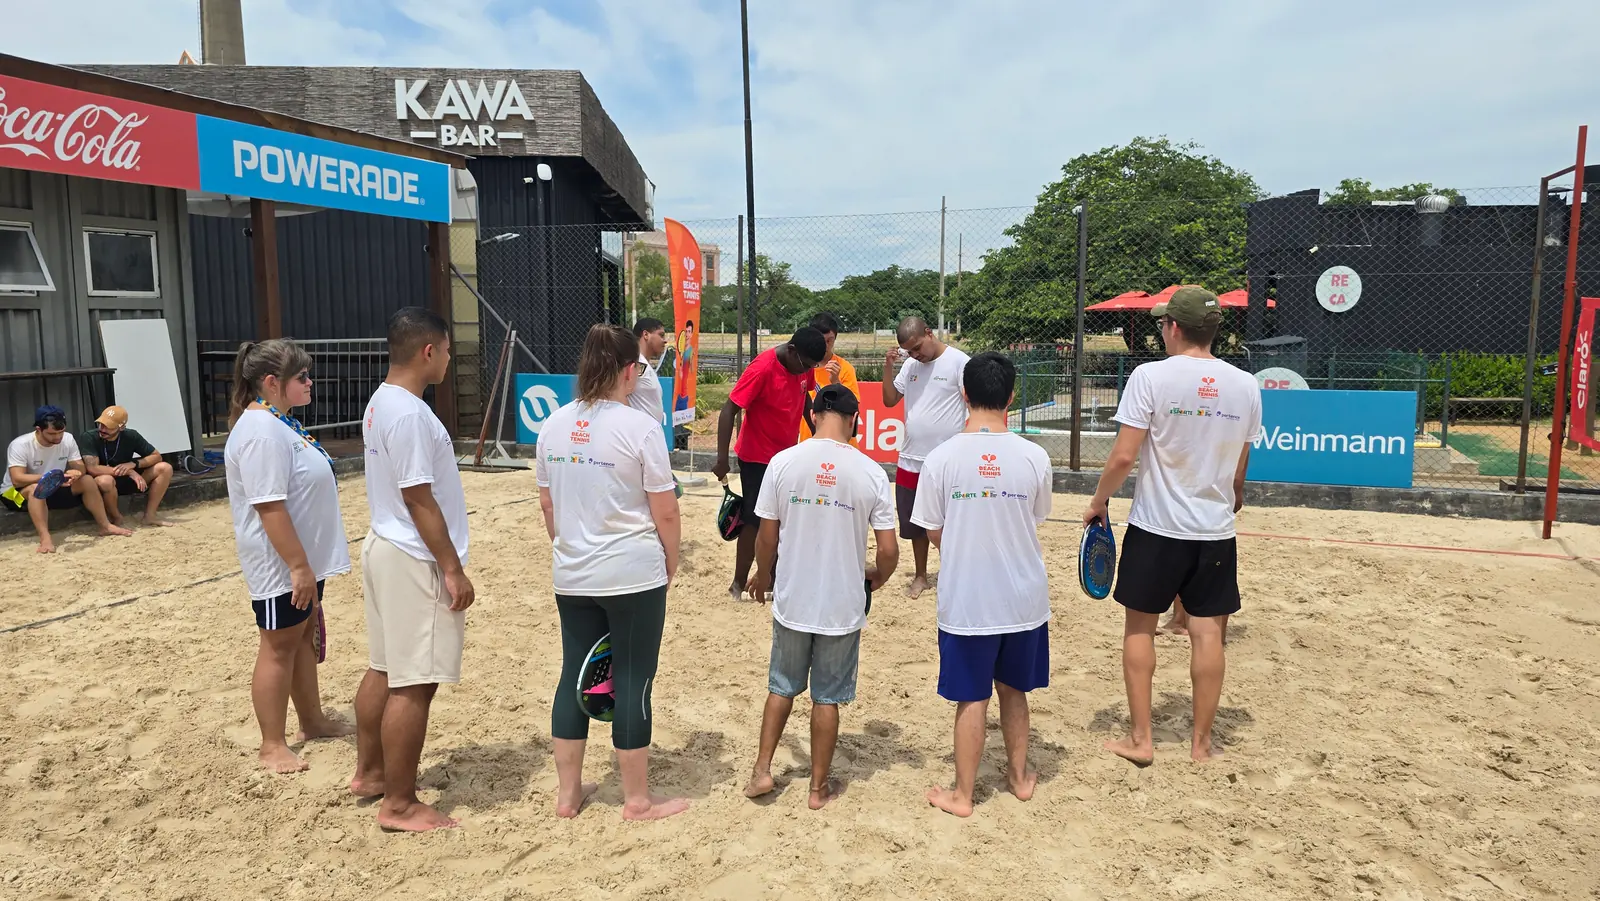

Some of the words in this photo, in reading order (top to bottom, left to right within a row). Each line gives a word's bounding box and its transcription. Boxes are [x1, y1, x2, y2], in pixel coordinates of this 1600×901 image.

[395, 79, 535, 121] KAWA
[0, 86, 149, 170] ca-Cola
[440, 124, 497, 146] BAR
[233, 140, 420, 205] POWERADE
[1331, 274, 1349, 287] RE
[1329, 293, 1346, 305] CA
[856, 409, 905, 452] la
[1253, 425, 1406, 455] Weinmann
